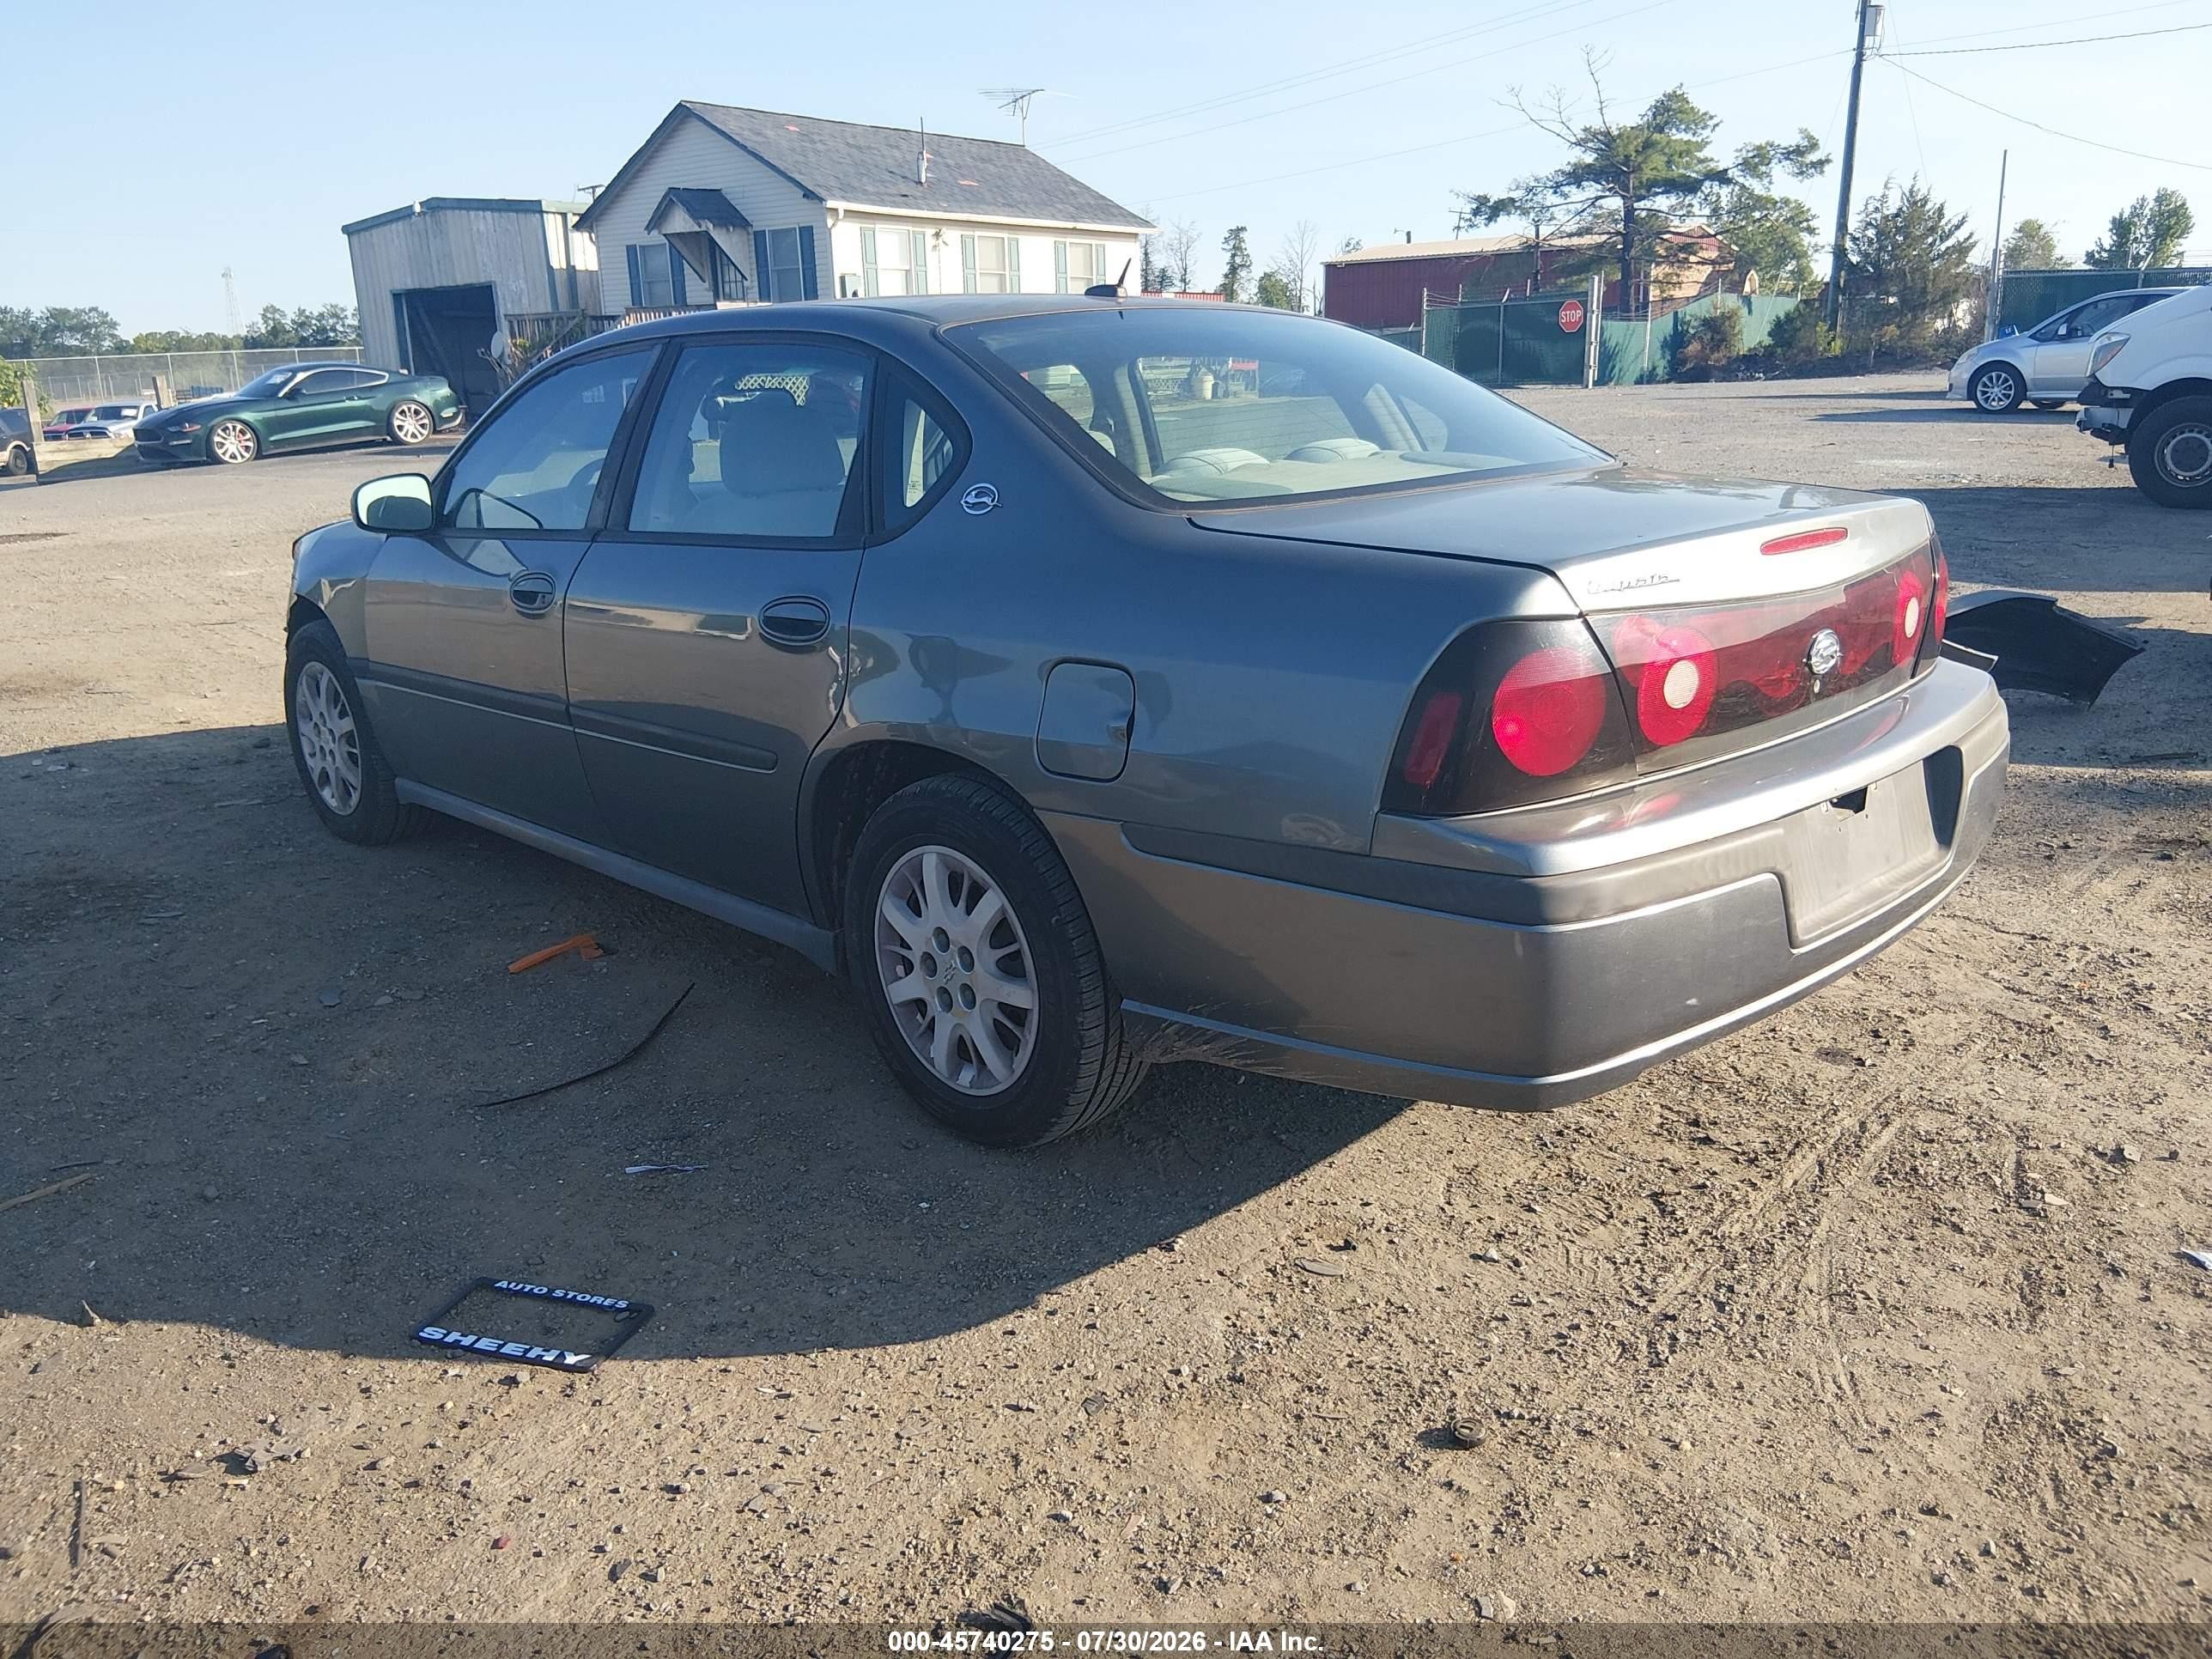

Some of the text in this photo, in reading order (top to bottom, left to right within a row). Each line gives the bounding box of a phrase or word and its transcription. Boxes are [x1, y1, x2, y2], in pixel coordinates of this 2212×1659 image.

[1561, 310, 1582, 323] STOP
[494, 1280, 629, 1309] AUTO STORES
[418, 1326, 592, 1365] SHEEHY
